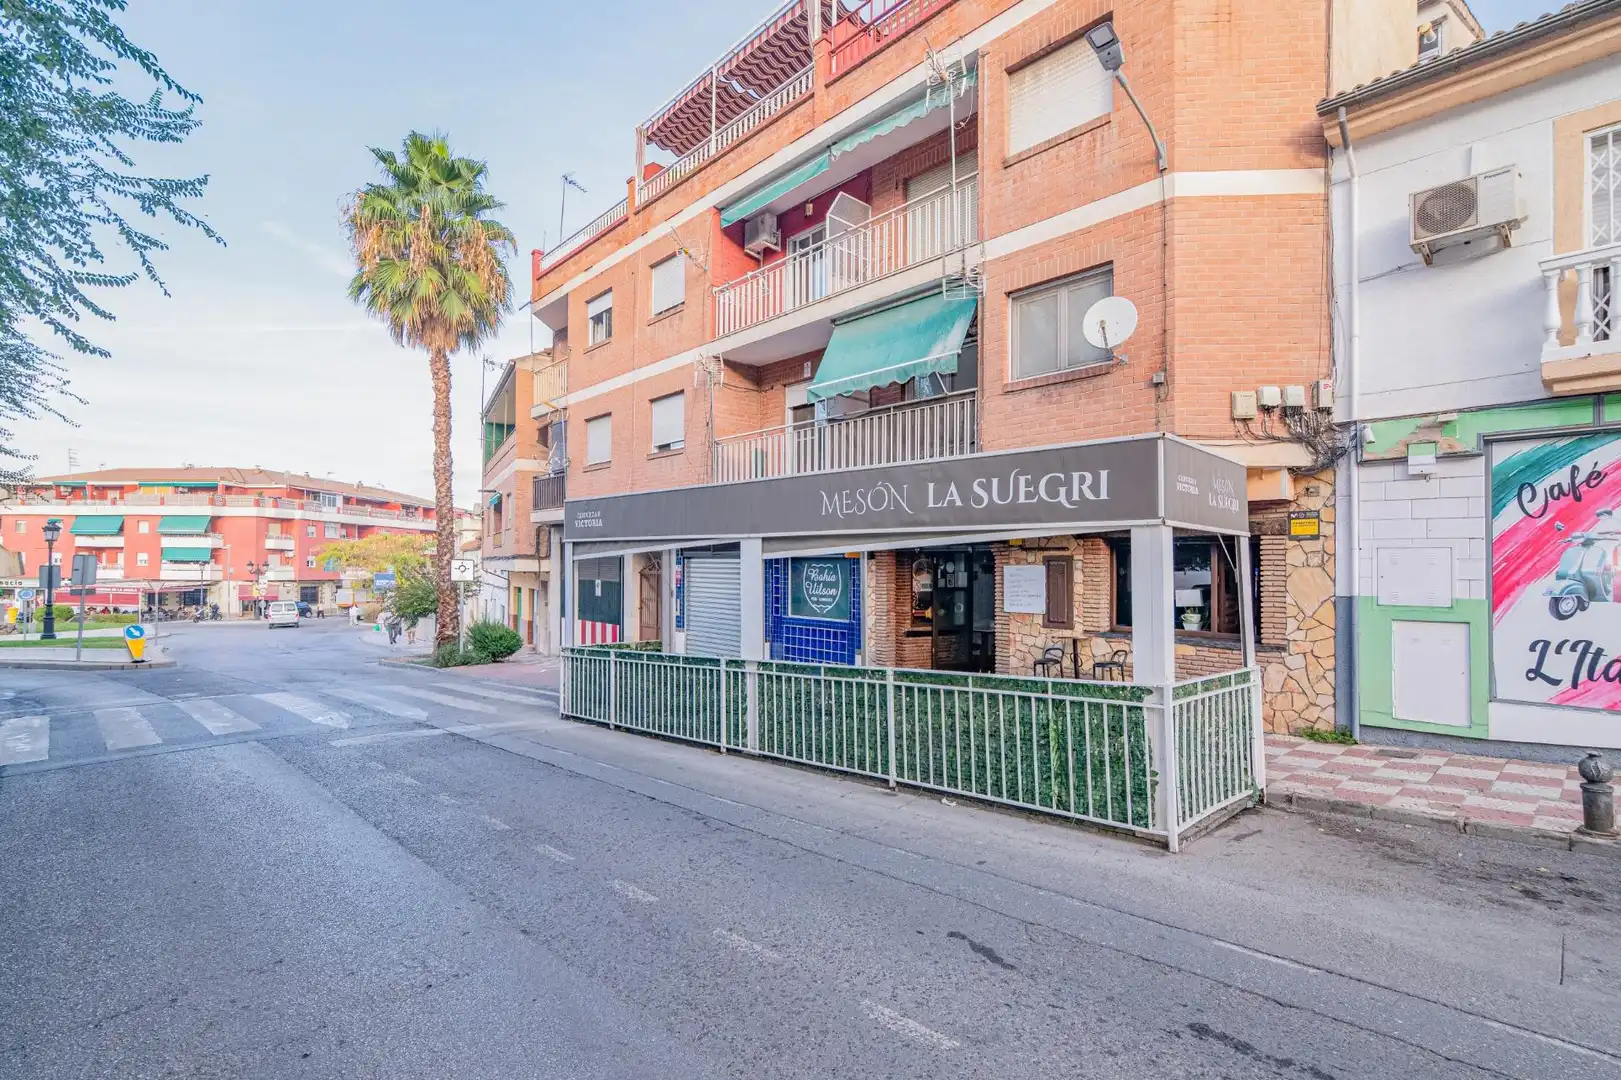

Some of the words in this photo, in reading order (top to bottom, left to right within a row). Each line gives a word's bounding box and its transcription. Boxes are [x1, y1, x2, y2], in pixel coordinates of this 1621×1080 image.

[819, 481, 915, 519] MESÓN
[927, 479, 964, 508] LA
[970, 468, 1111, 509] SUEGRI
[1516, 460, 1608, 519] Café
[574, 518, 603, 528] VICTORIA
